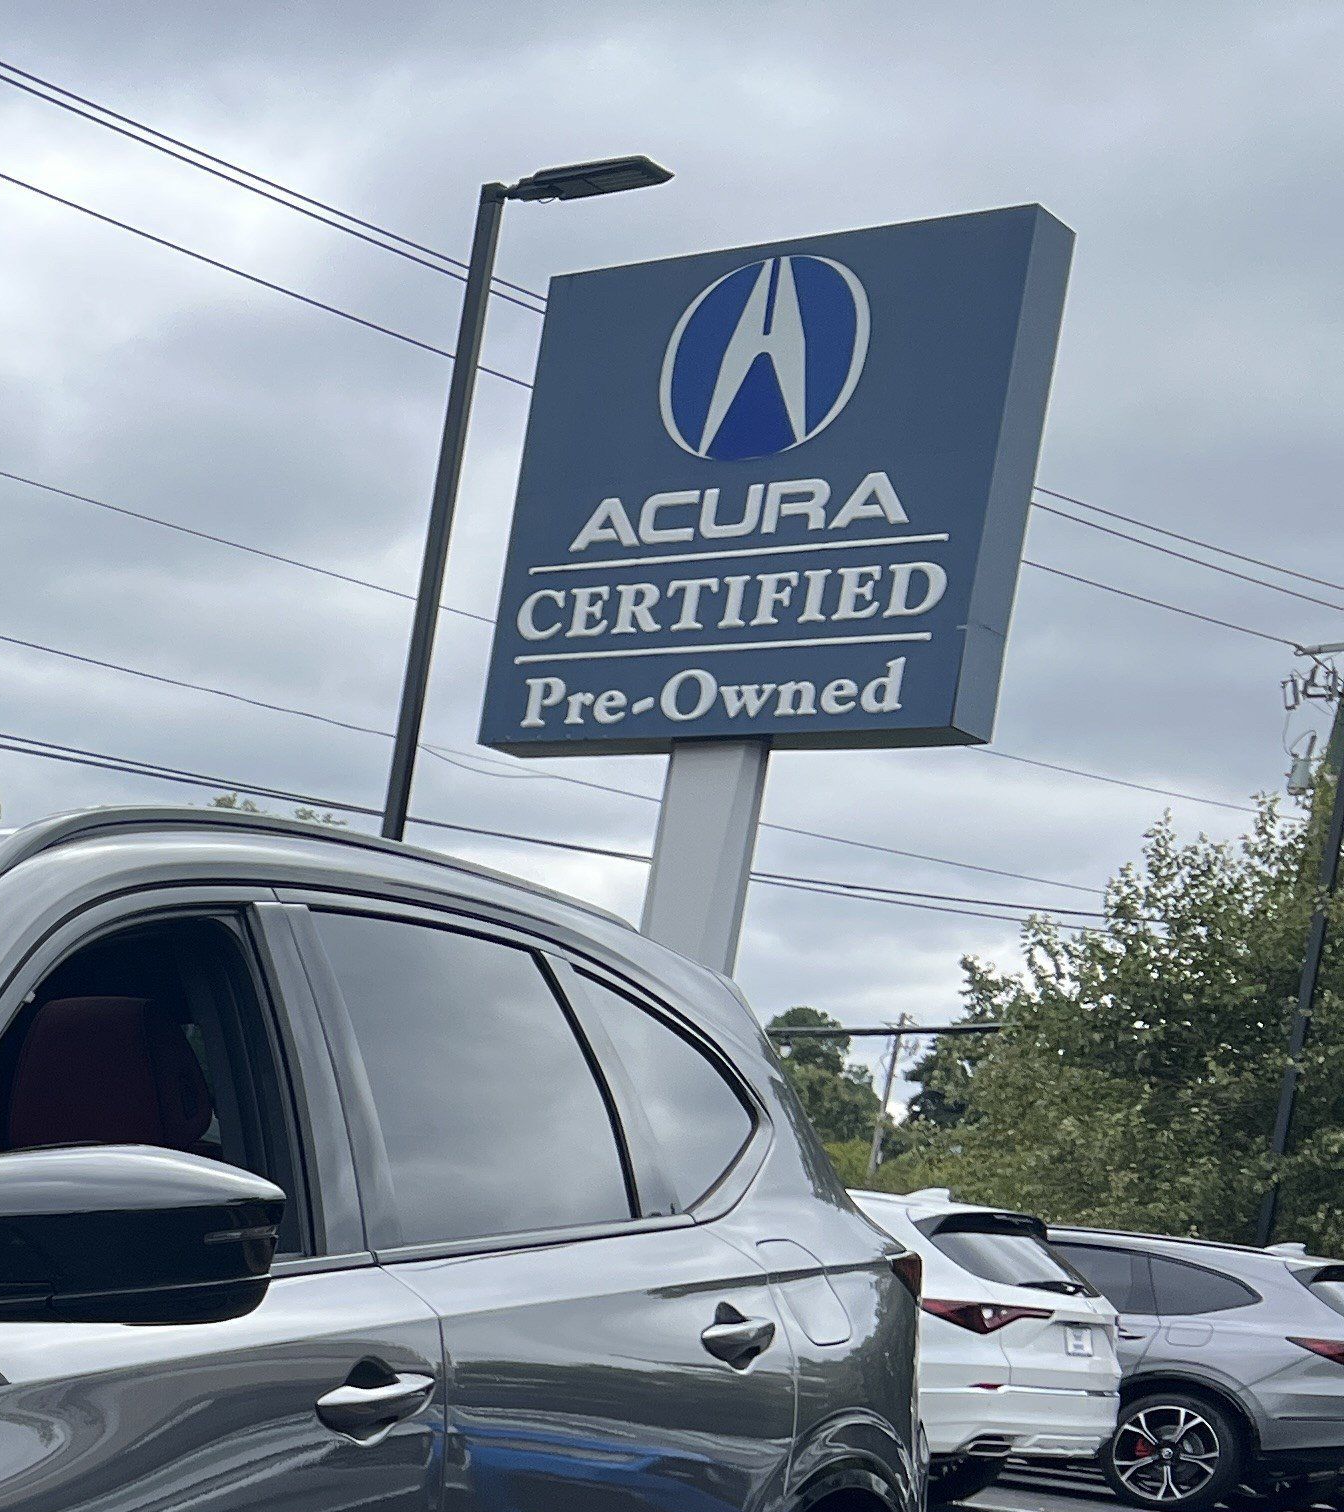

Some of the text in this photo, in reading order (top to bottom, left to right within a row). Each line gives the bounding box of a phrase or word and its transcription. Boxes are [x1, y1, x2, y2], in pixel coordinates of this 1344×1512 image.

[568, 471, 910, 553] ACURA
[516, 561, 948, 642] CERTIFIED
[519, 656, 907, 729] Pre-Owned
